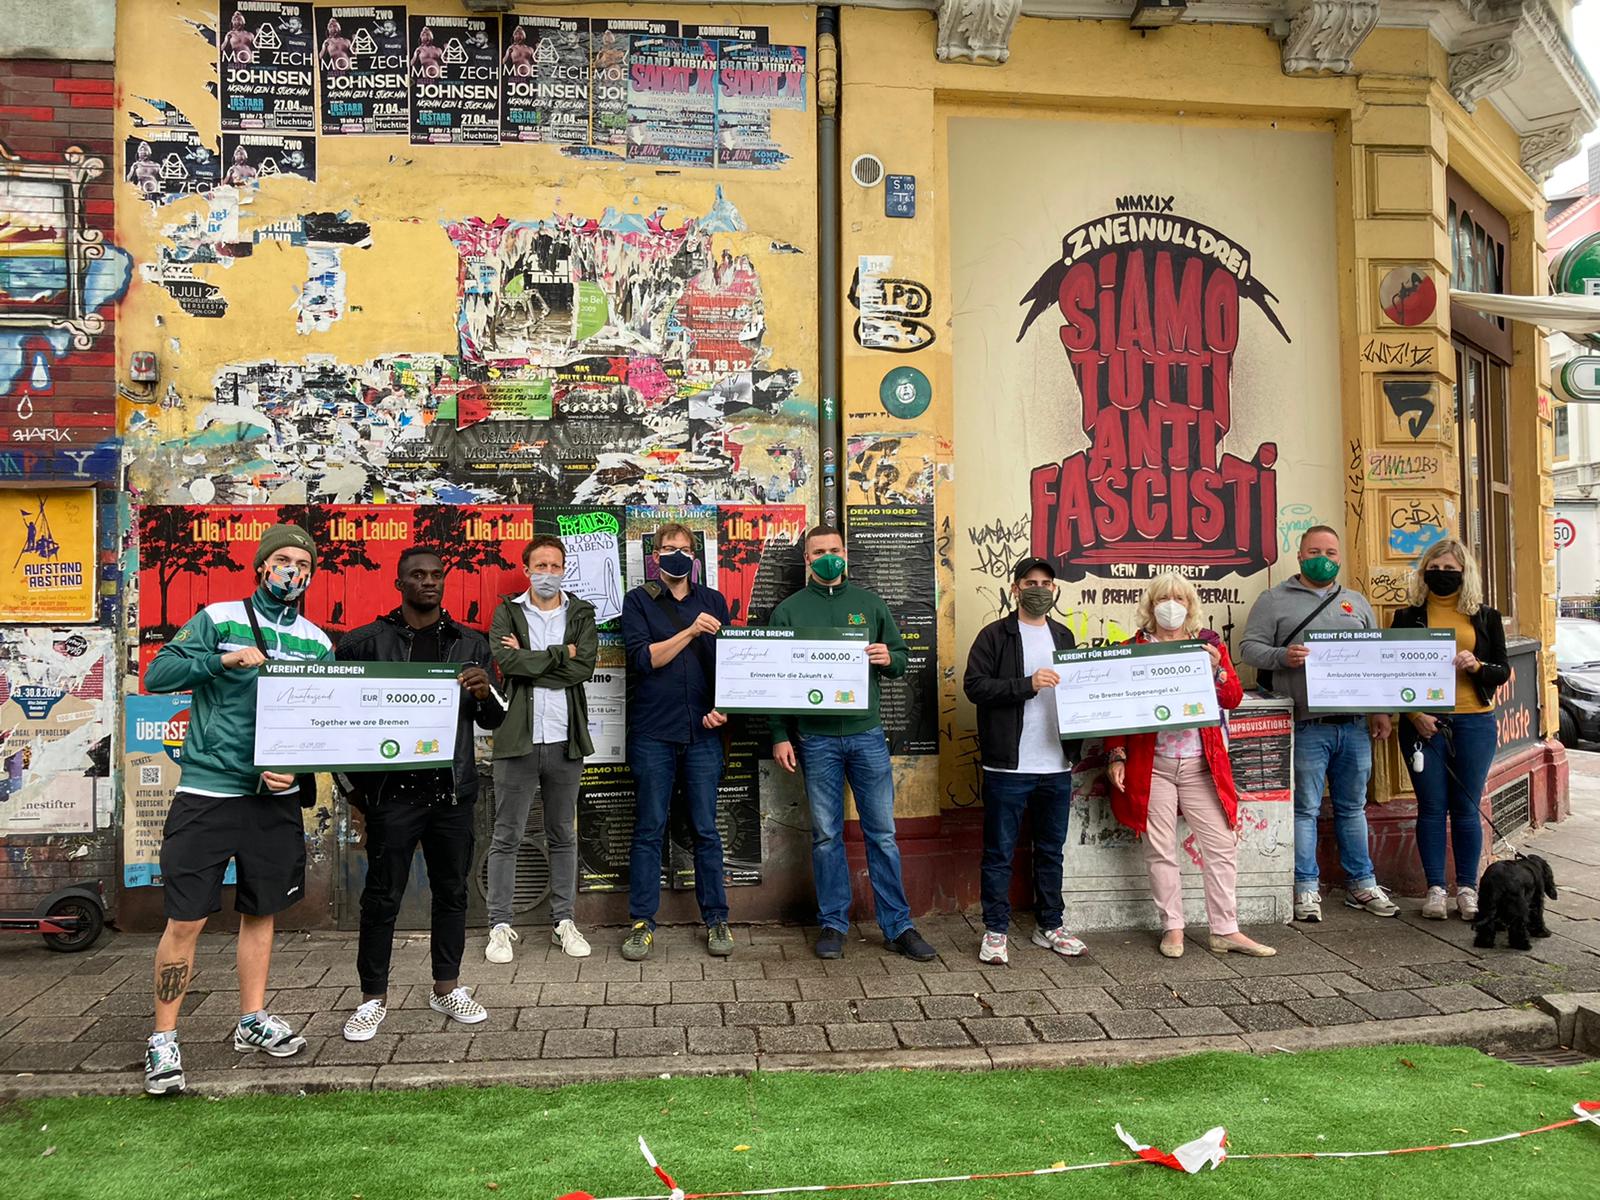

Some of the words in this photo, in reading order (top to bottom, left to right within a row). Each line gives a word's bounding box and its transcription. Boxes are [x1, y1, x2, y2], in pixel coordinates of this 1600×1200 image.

[238, 1, 282, 12] KOMMUNE
[282, 5, 300, 16] ZWO
[332, 8, 376, 18] KOMMUNE
[376, 10, 394, 20] ZWO
[426, 17, 468, 28] KOMMUNE
[468, 20, 486, 31] ZWO
[519, 16, 560, 28] KOMMUNE
[560, 22, 578, 32] ZWO
[608, 20, 650, 30] KOMMUNE
[650, 24, 666, 34] ZWO
[699, 26, 740, 37] KOMMUNE
[739, 30, 756, 40] ZWO
[222, 50, 260, 64] MOE
[272, 51, 313, 66] ZECH
[321, 57, 358, 71] MOE
[370, 55, 408, 69] ZECH
[630, 54, 670, 67] BRAND
[673, 59, 717, 70] NUBIAN
[412, 65, 448, 78] MOE
[460, 67, 498, 80] ZECH
[503, 64, 539, 77] MOE
[550, 66, 589, 80] ZECH
[720, 60, 759, 71] BRAND
[762, 63, 805, 73] NUBIAN
[226, 69, 312, 85] JOHNSEN
[326, 74, 408, 89] JOHNSEN
[416, 84, 498, 99] JOHNSEN
[507, 83, 588, 99] JOHNSEN
[276, 118, 312, 126] Huchting
[240, 136, 284, 146] KOMMUNE
[284, 140, 302, 151] ZWO
[464, 132, 498, 141] Huchting
[663, 146, 712, 157] KOMPLETTE
[669, 153, 706, 162] PALETTE
[894, 180, 900, 190] S
[1116, 195, 1175, 212] MMXIX
[1067, 216, 1249, 280] ZWEINULLDREI
[178, 287, 202, 297] JULI
[1070, 349, 1233, 431] TUTTI
[12, 427, 72, 441] SHARK
[1088, 402, 1218, 482] ANTI
[634, 509, 674, 518] Ecstatic
[679, 509, 711, 518] Dance
[193, 519, 219, 542] Lila
[330, 519, 356, 542] Lila
[363, 519, 408, 542] Laube
[466, 519, 491, 540] Lila
[728, 519, 751, 540] Lila
[1553, 526, 1570, 540] 50
[574, 535, 612, 544] DOWN
[25, 562, 82, 575] AUFSTAND
[1110, 564, 1137, 577] KEIN
[30, 575, 82, 587] ABSTAND
[1058, 653, 1086, 661] VEREINT
[1089, 650, 1102, 658] FÜR
[1104, 648, 1132, 657] BREMEN
[266, 665, 305, 673] VEREINT
[307, 664, 325, 673] FÜR
[328, 666, 364, 674] BREMEN
[1125, 688, 1168, 697] Suppenengel
[136, 718, 189, 740] ÜBERSE
[310, 719, 348, 727] Together
[378, 718, 409, 726] Bremen
